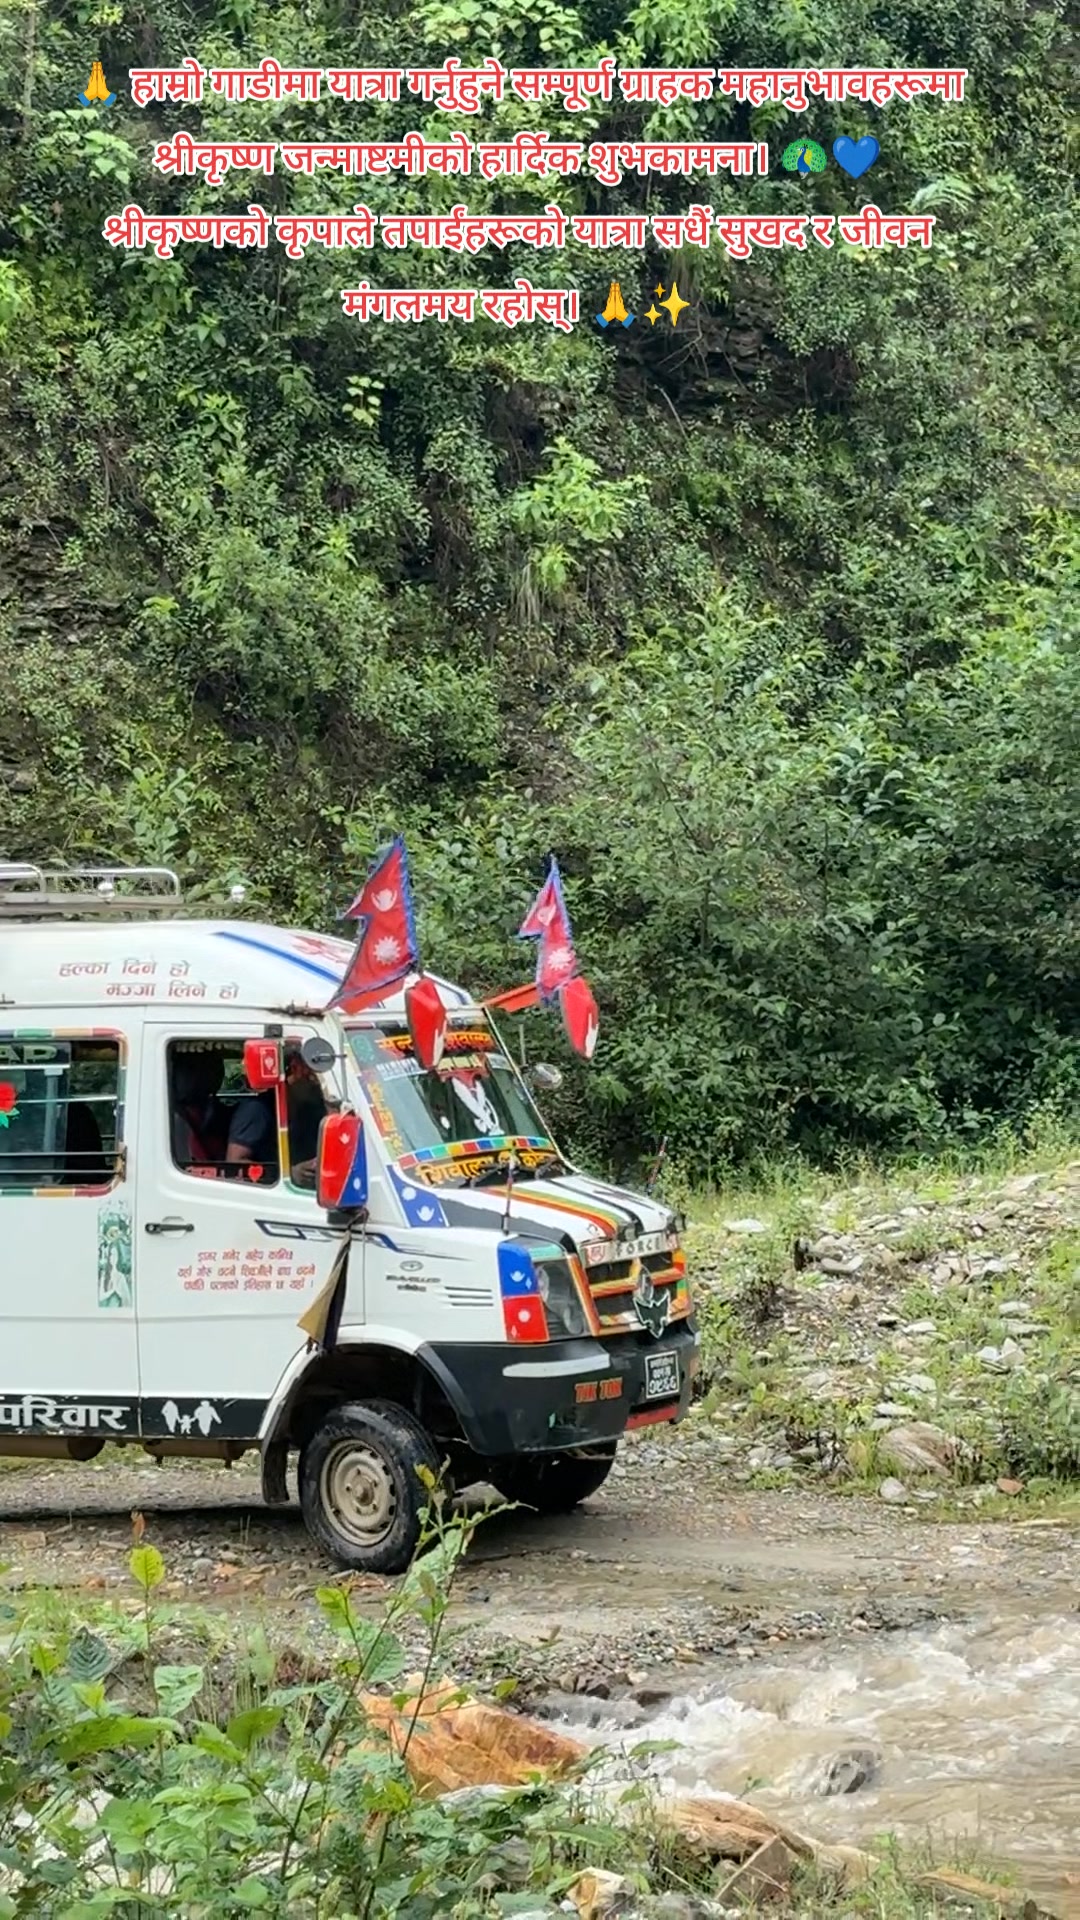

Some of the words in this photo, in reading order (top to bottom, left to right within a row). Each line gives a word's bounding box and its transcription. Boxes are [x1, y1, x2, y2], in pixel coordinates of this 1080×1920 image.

[169, 959, 190, 977] हो
[218, 981, 240, 999] हो
[616, 1237, 661, 1258] FORCE
[0, 1395, 131, 1430] परिवार
